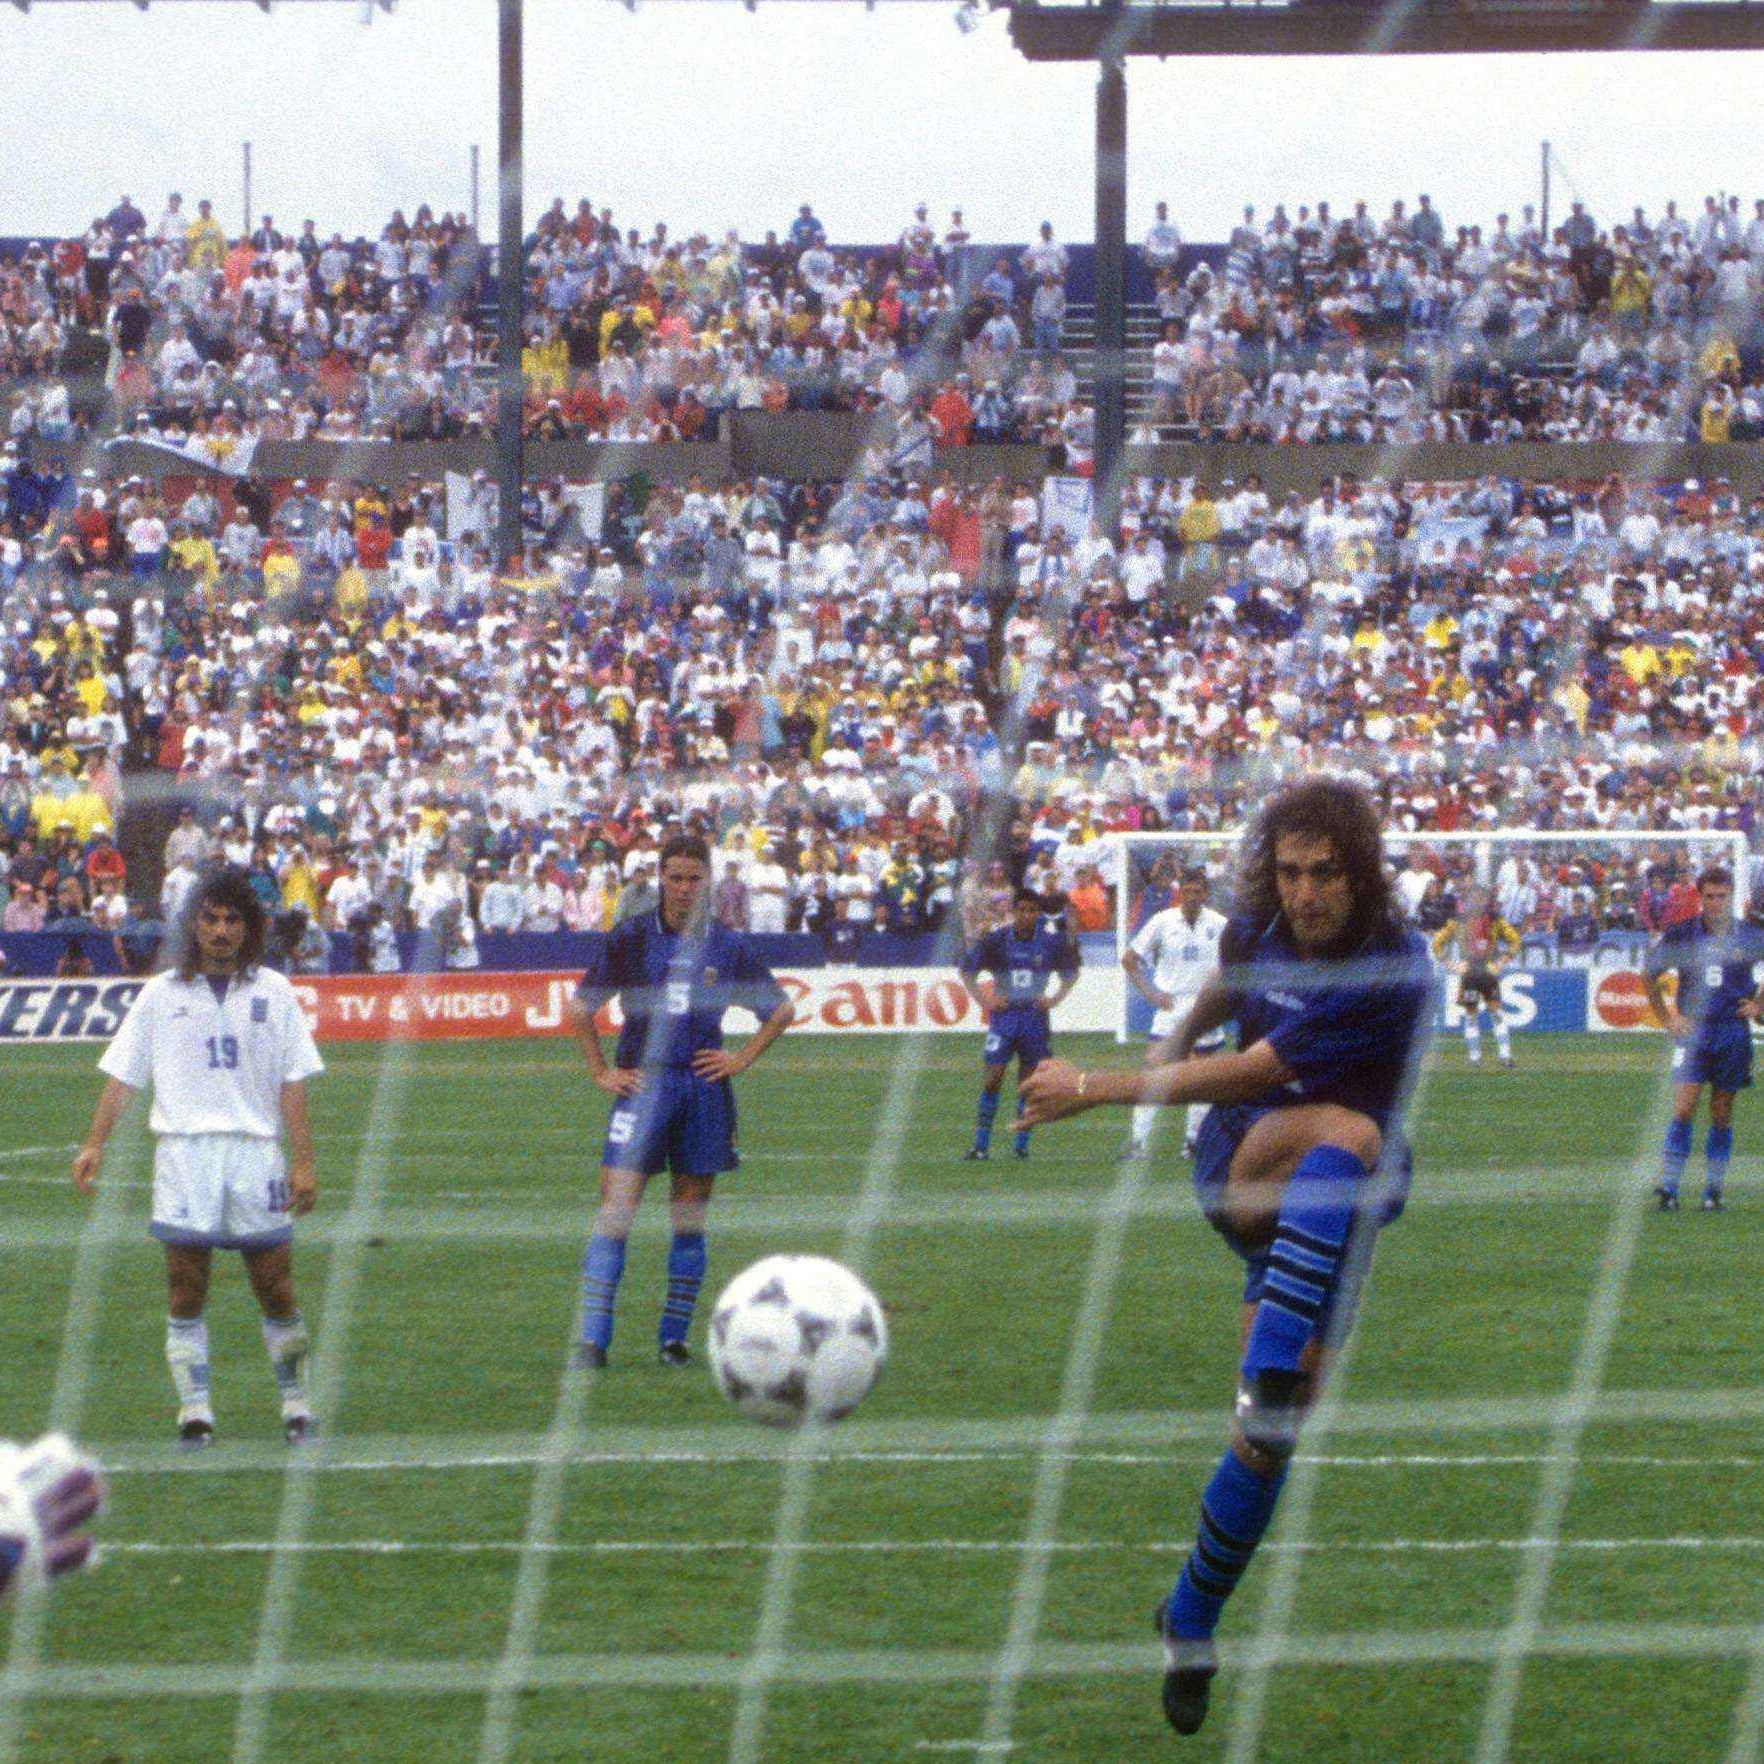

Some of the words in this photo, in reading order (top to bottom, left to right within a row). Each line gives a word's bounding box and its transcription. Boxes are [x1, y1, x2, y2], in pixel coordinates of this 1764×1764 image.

[337, 994, 375, 1022] TV
[388, 994, 410, 1022] &
[419, 991, 511, 1020] VIDEO
[667, 981, 688, 1015] 5
[774, 976, 990, 1028] Cano
[205, 1036, 237, 1069] 19
[609, 1109, 637, 1144] 5
